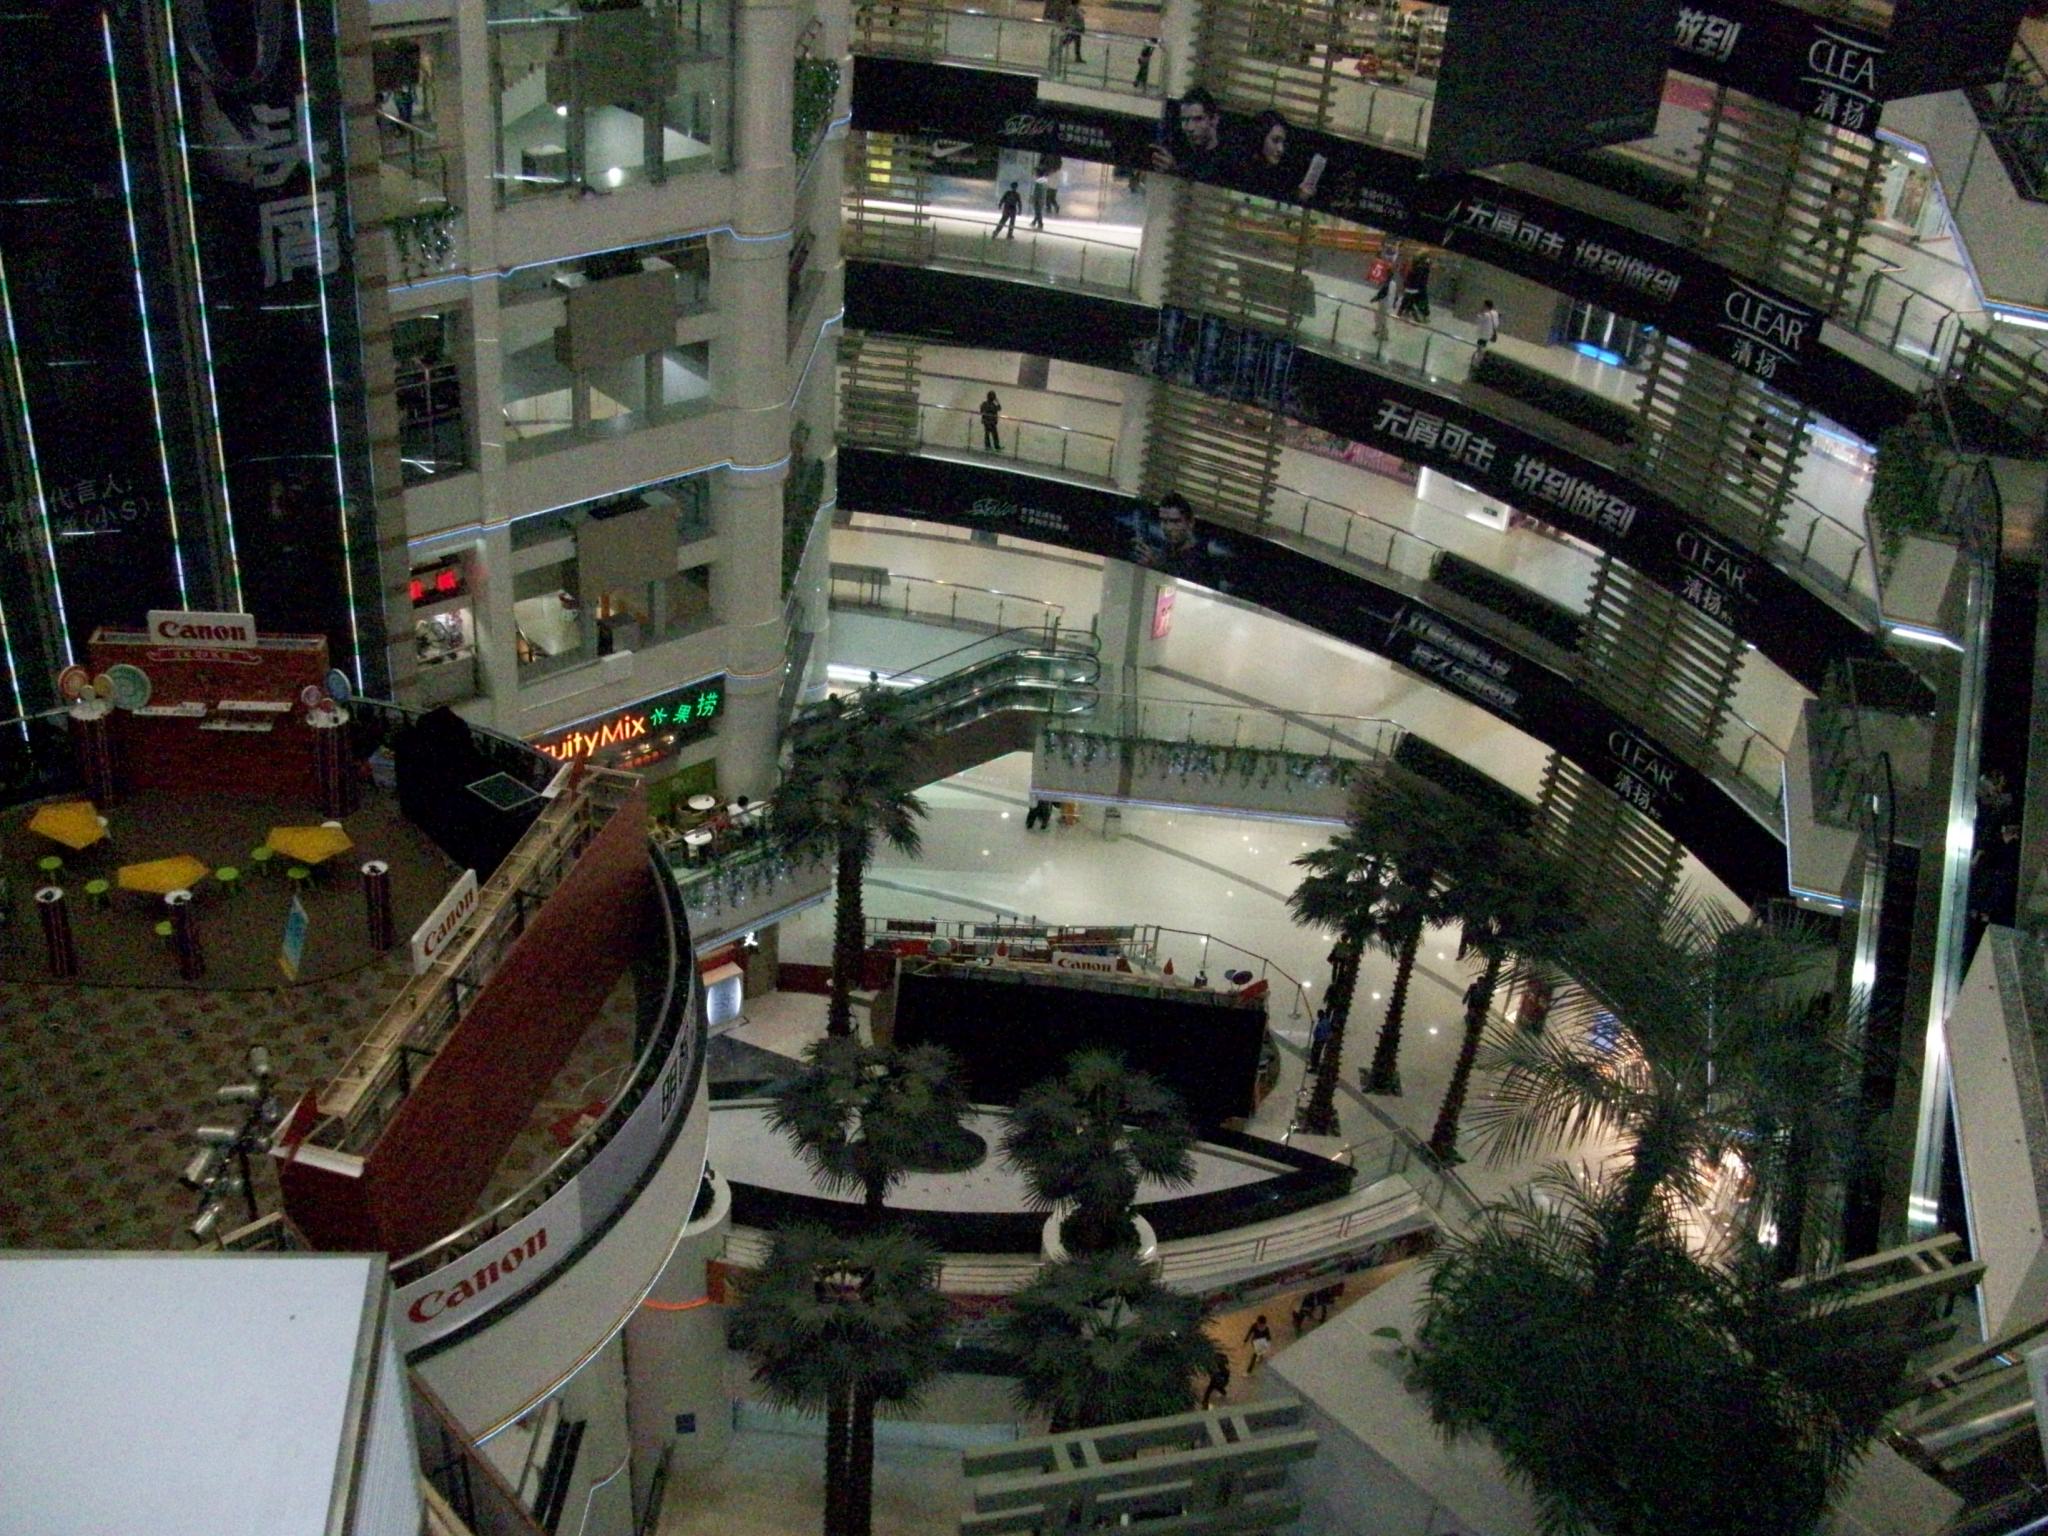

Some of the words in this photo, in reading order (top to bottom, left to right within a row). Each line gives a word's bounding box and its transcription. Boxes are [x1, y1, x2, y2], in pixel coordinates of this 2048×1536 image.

[1813, 88, 1865, 130] 清扬
[1466, 197, 1565, 257] 无屑可击
[1574, 238, 1681, 299] 说到做到
[1725, 290, 1802, 351] CLEAR
[1731, 337, 1777, 378] 清扬
[1373, 397, 1498, 474] 无屑可击
[1513, 453, 1638, 536] 说到做到
[1676, 531, 1746, 594] CLEAR
[1681, 574, 1722, 616] 清扬
[158, 620, 246, 641] Canon
[650, 692, 718, 726] 水果捞
[1608, 731, 1675, 793] CLEAR
[1613, 769, 1651, 810] 清扬
[424, 888, 473, 956] Canon
[1058, 958, 1111, 972] Canon
[408, 1228, 547, 1323] Canon
